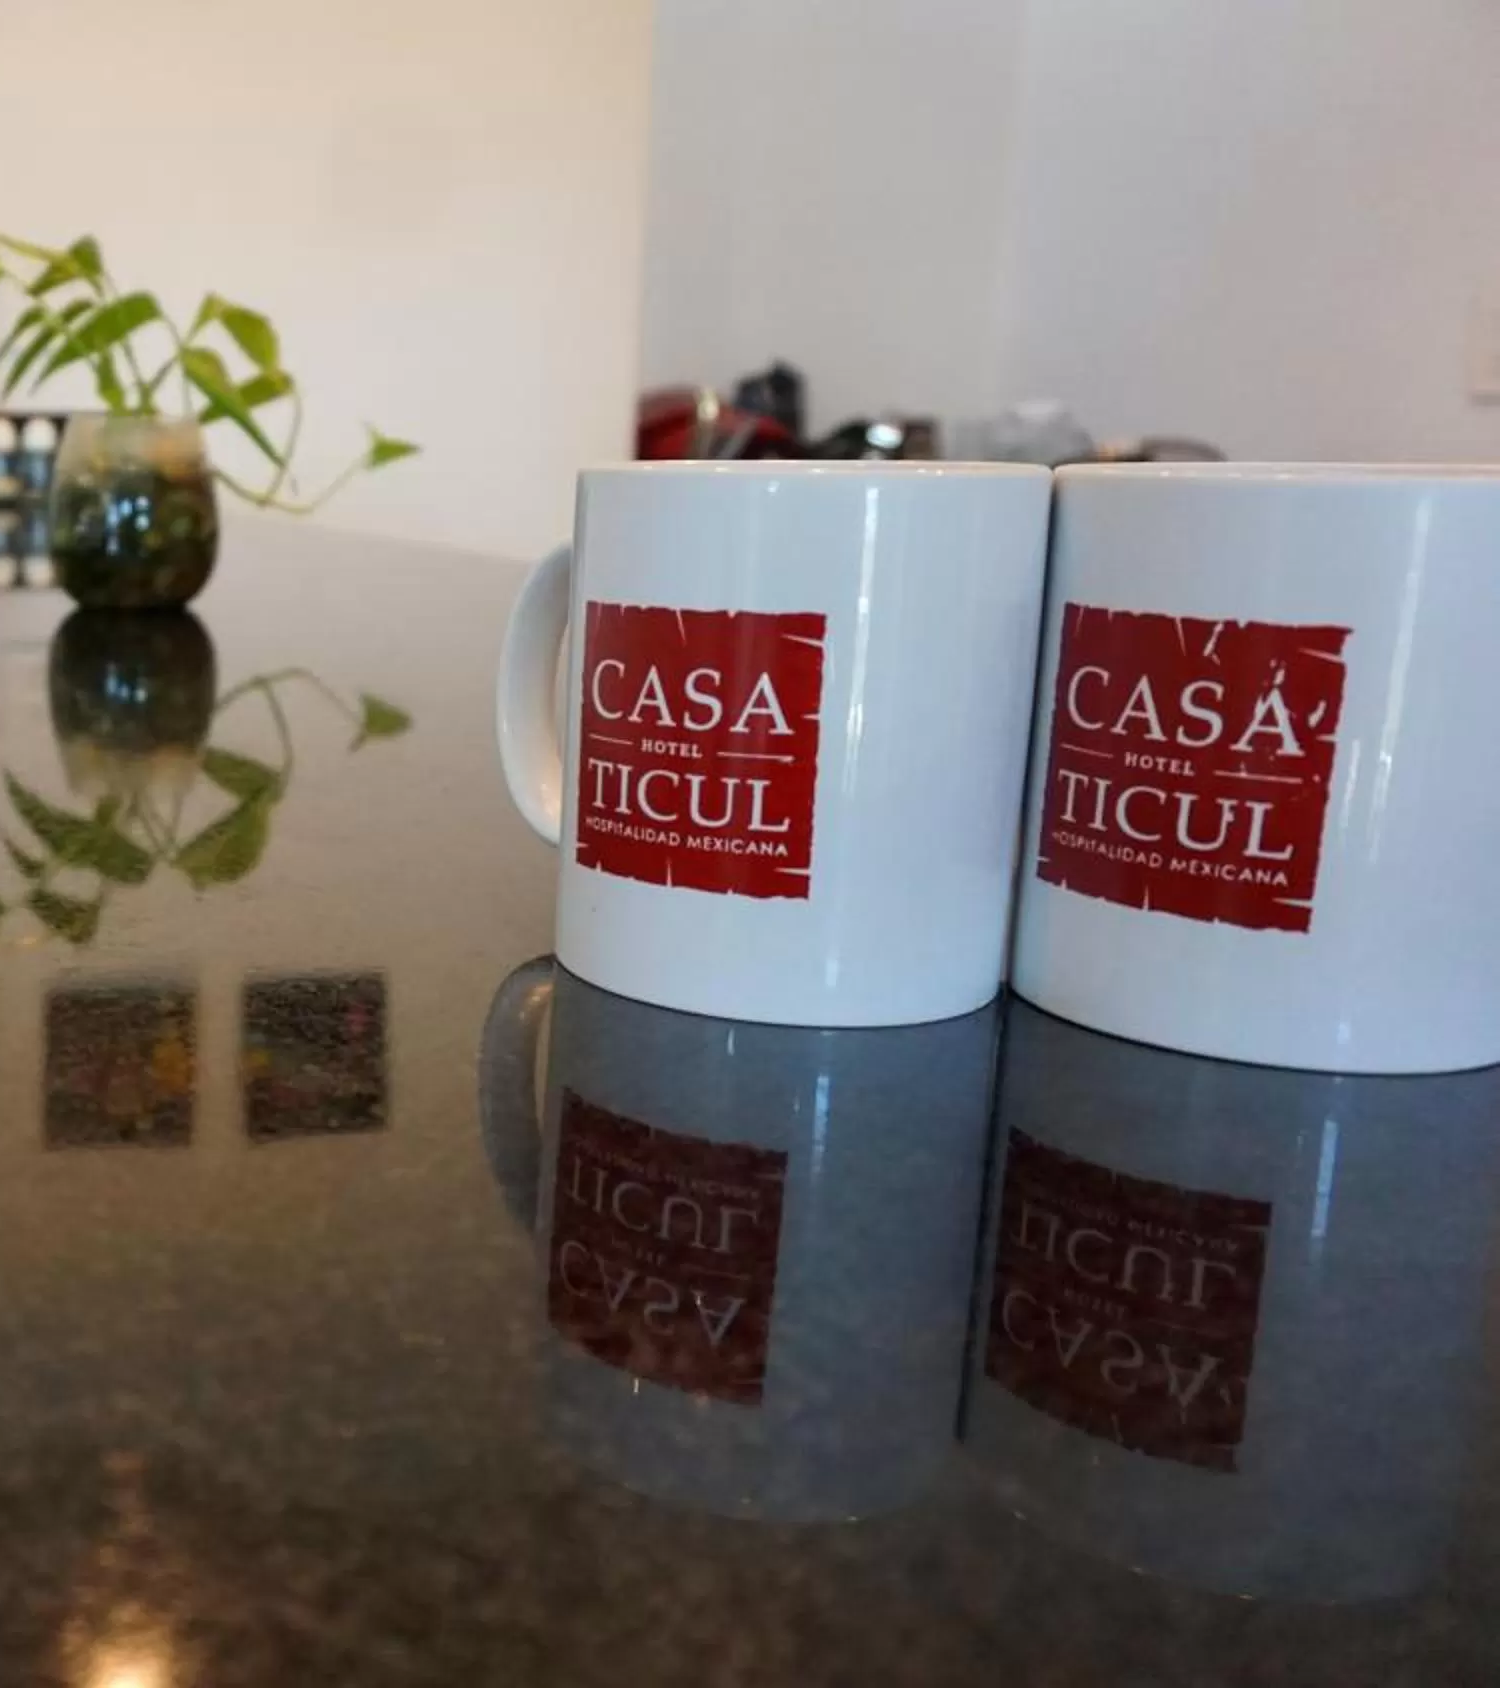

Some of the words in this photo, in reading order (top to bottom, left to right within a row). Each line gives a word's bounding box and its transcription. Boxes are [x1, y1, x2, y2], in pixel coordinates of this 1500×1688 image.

[591, 658, 795, 736] CASA
[1067, 665, 1305, 757] CASA
[640, 738, 704, 759] HOTEL
[1124, 751, 1195, 777] HOTEL
[588, 757, 791, 833] TICUL
[1057, 768, 1294, 861] TICUL
[585, 816, 681, 847] HOSPITALIDAD
[686, 835, 788, 858] MEXICANA
[1169, 857, 1288, 887] MEXICANA
